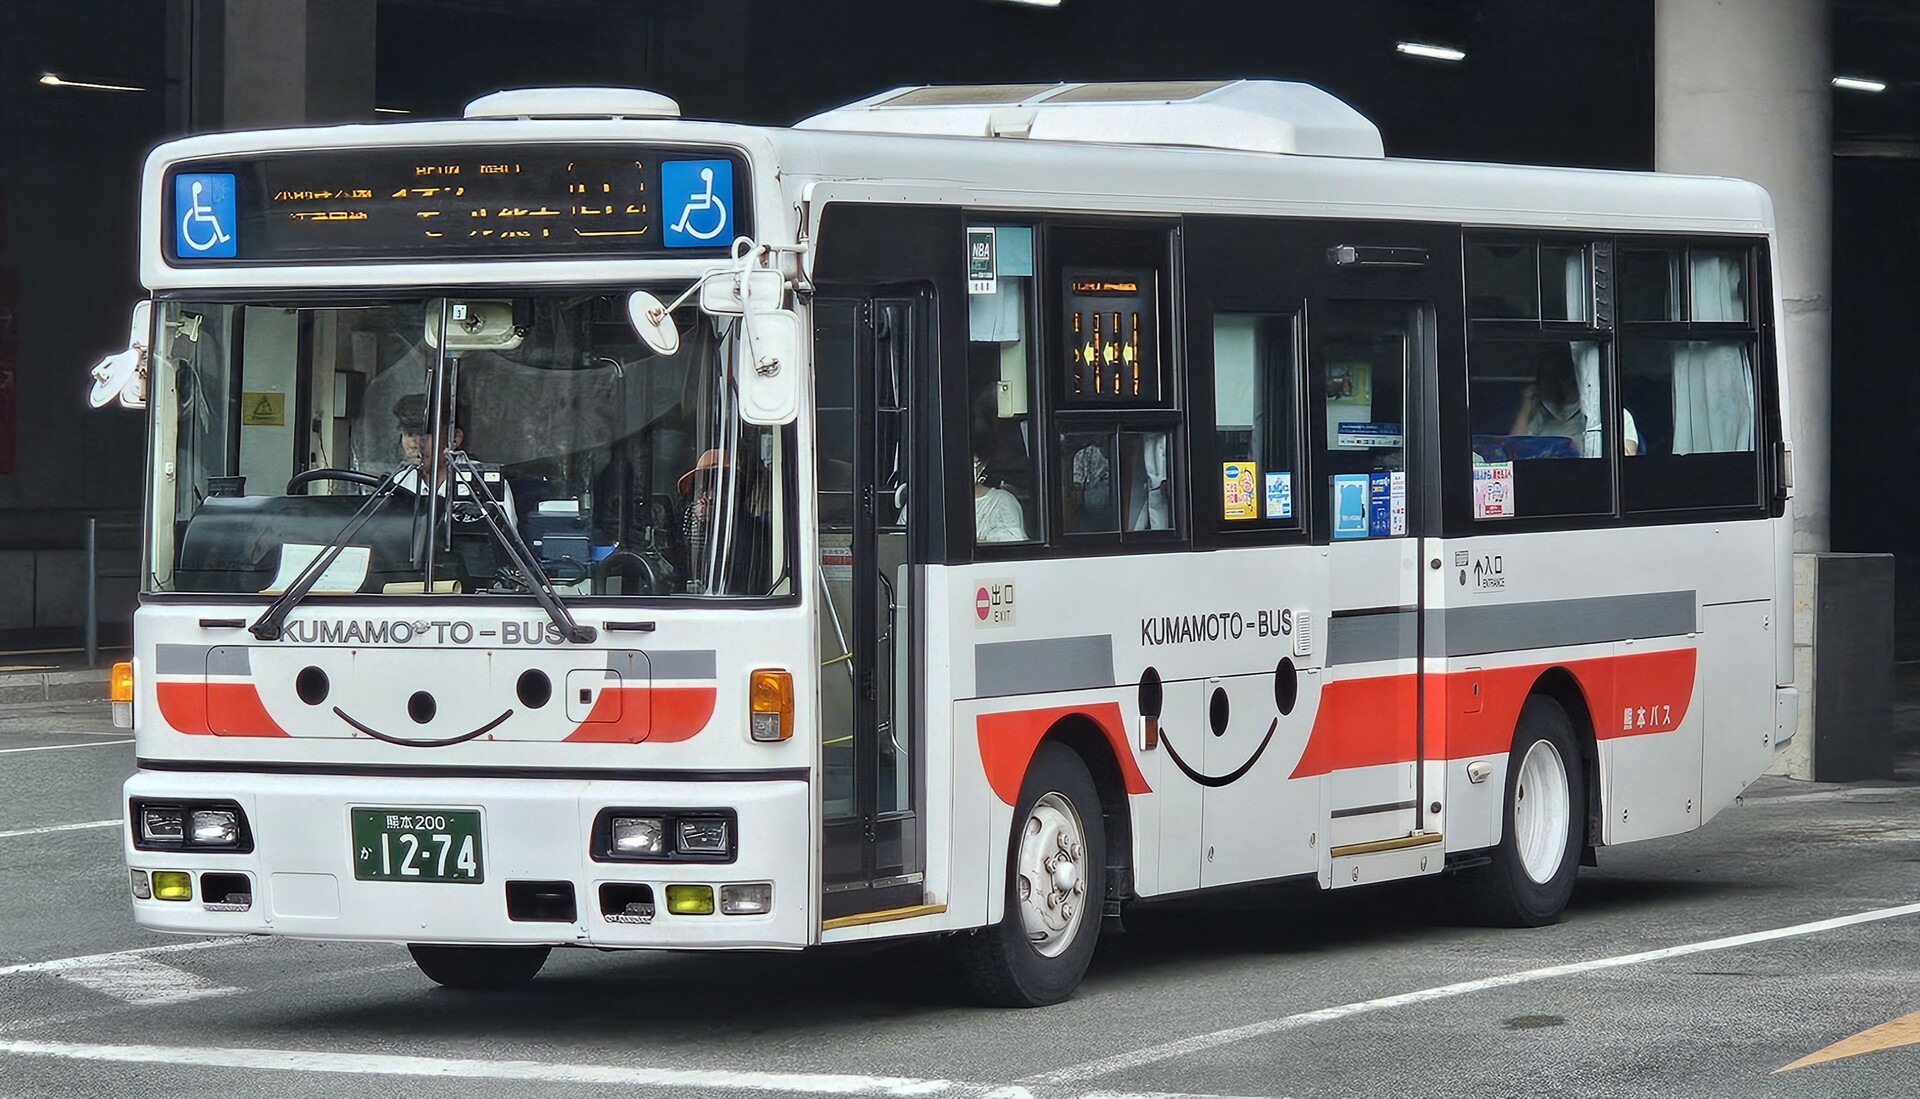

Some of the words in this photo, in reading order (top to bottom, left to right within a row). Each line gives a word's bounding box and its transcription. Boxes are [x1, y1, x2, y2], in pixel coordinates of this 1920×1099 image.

[1484, 555, 1503, 575] 入口
[991, 583, 1014, 605] 出口
[381, 833, 477, 877] 12-74
